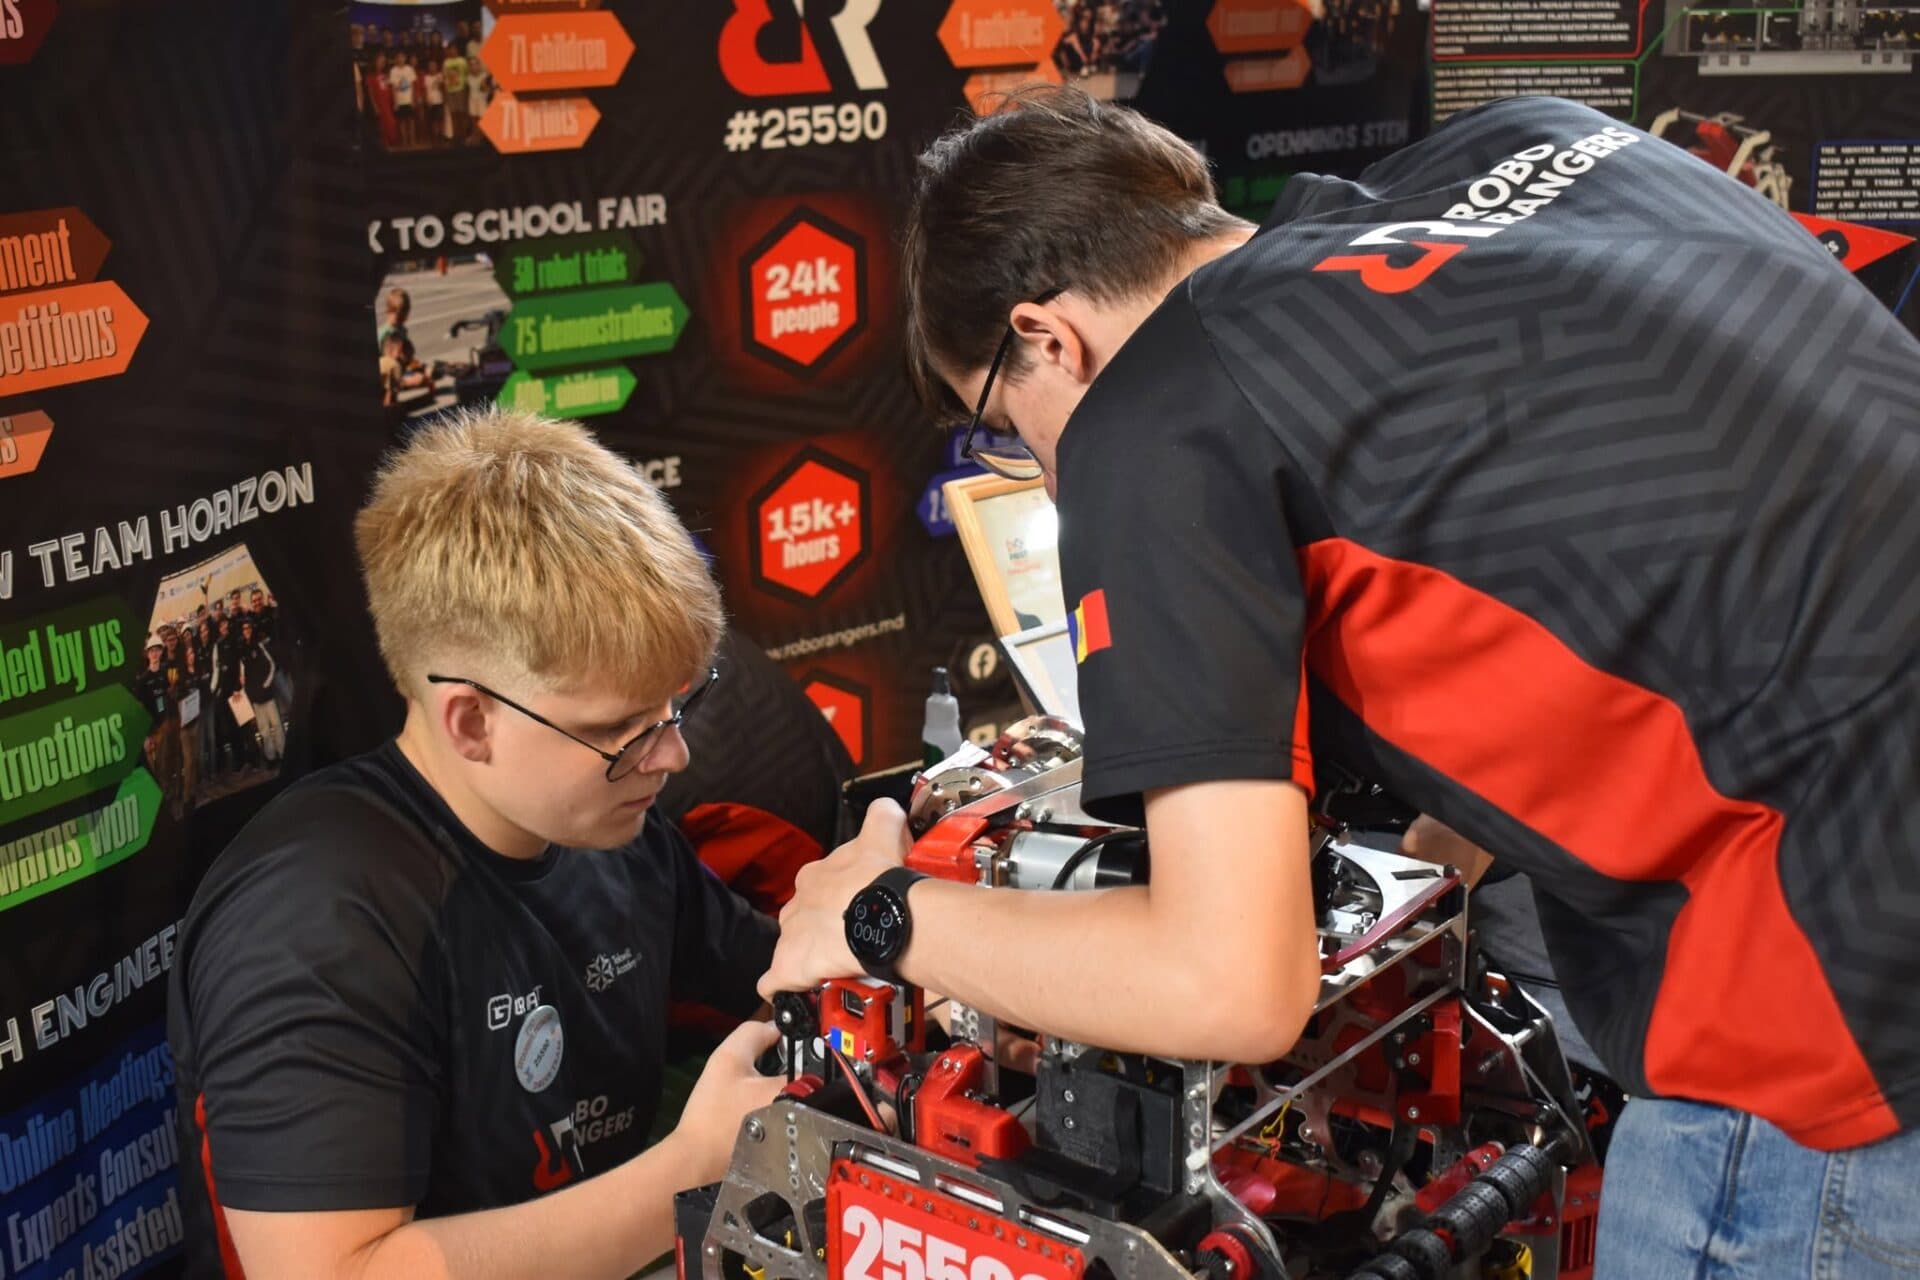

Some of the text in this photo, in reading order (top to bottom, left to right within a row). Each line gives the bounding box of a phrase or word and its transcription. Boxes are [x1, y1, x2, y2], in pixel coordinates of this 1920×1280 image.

[725, 102, 888, 151] #25590
[1442, 143, 1555, 220] ROBO
[1480, 127, 1641, 225] RANGERS
[392, 214, 445, 251] TO
[451, 201, 592, 246] SCHOOL
[598, 193, 667, 231] FAIR
[765, 258, 840, 301] 24k
[0, 302, 117, 376] etitions
[771, 299, 840, 339] people
[29, 515, 153, 588] TEAM
[160, 462, 314, 554] HORIZON
[783, 534, 841, 569] hours
[46, 623, 86, 694] by
[89, 618, 127, 673] us
[853, 921, 887, 946] 11:00
[31, 919, 184, 1051] ENGINEE
[80, 1041, 176, 1144] Meetings
[7, 1107, 180, 1273] Experts Consul
[82, 1186, 185, 1280] Assisted
[842, 1204, 1048, 1280] 255
